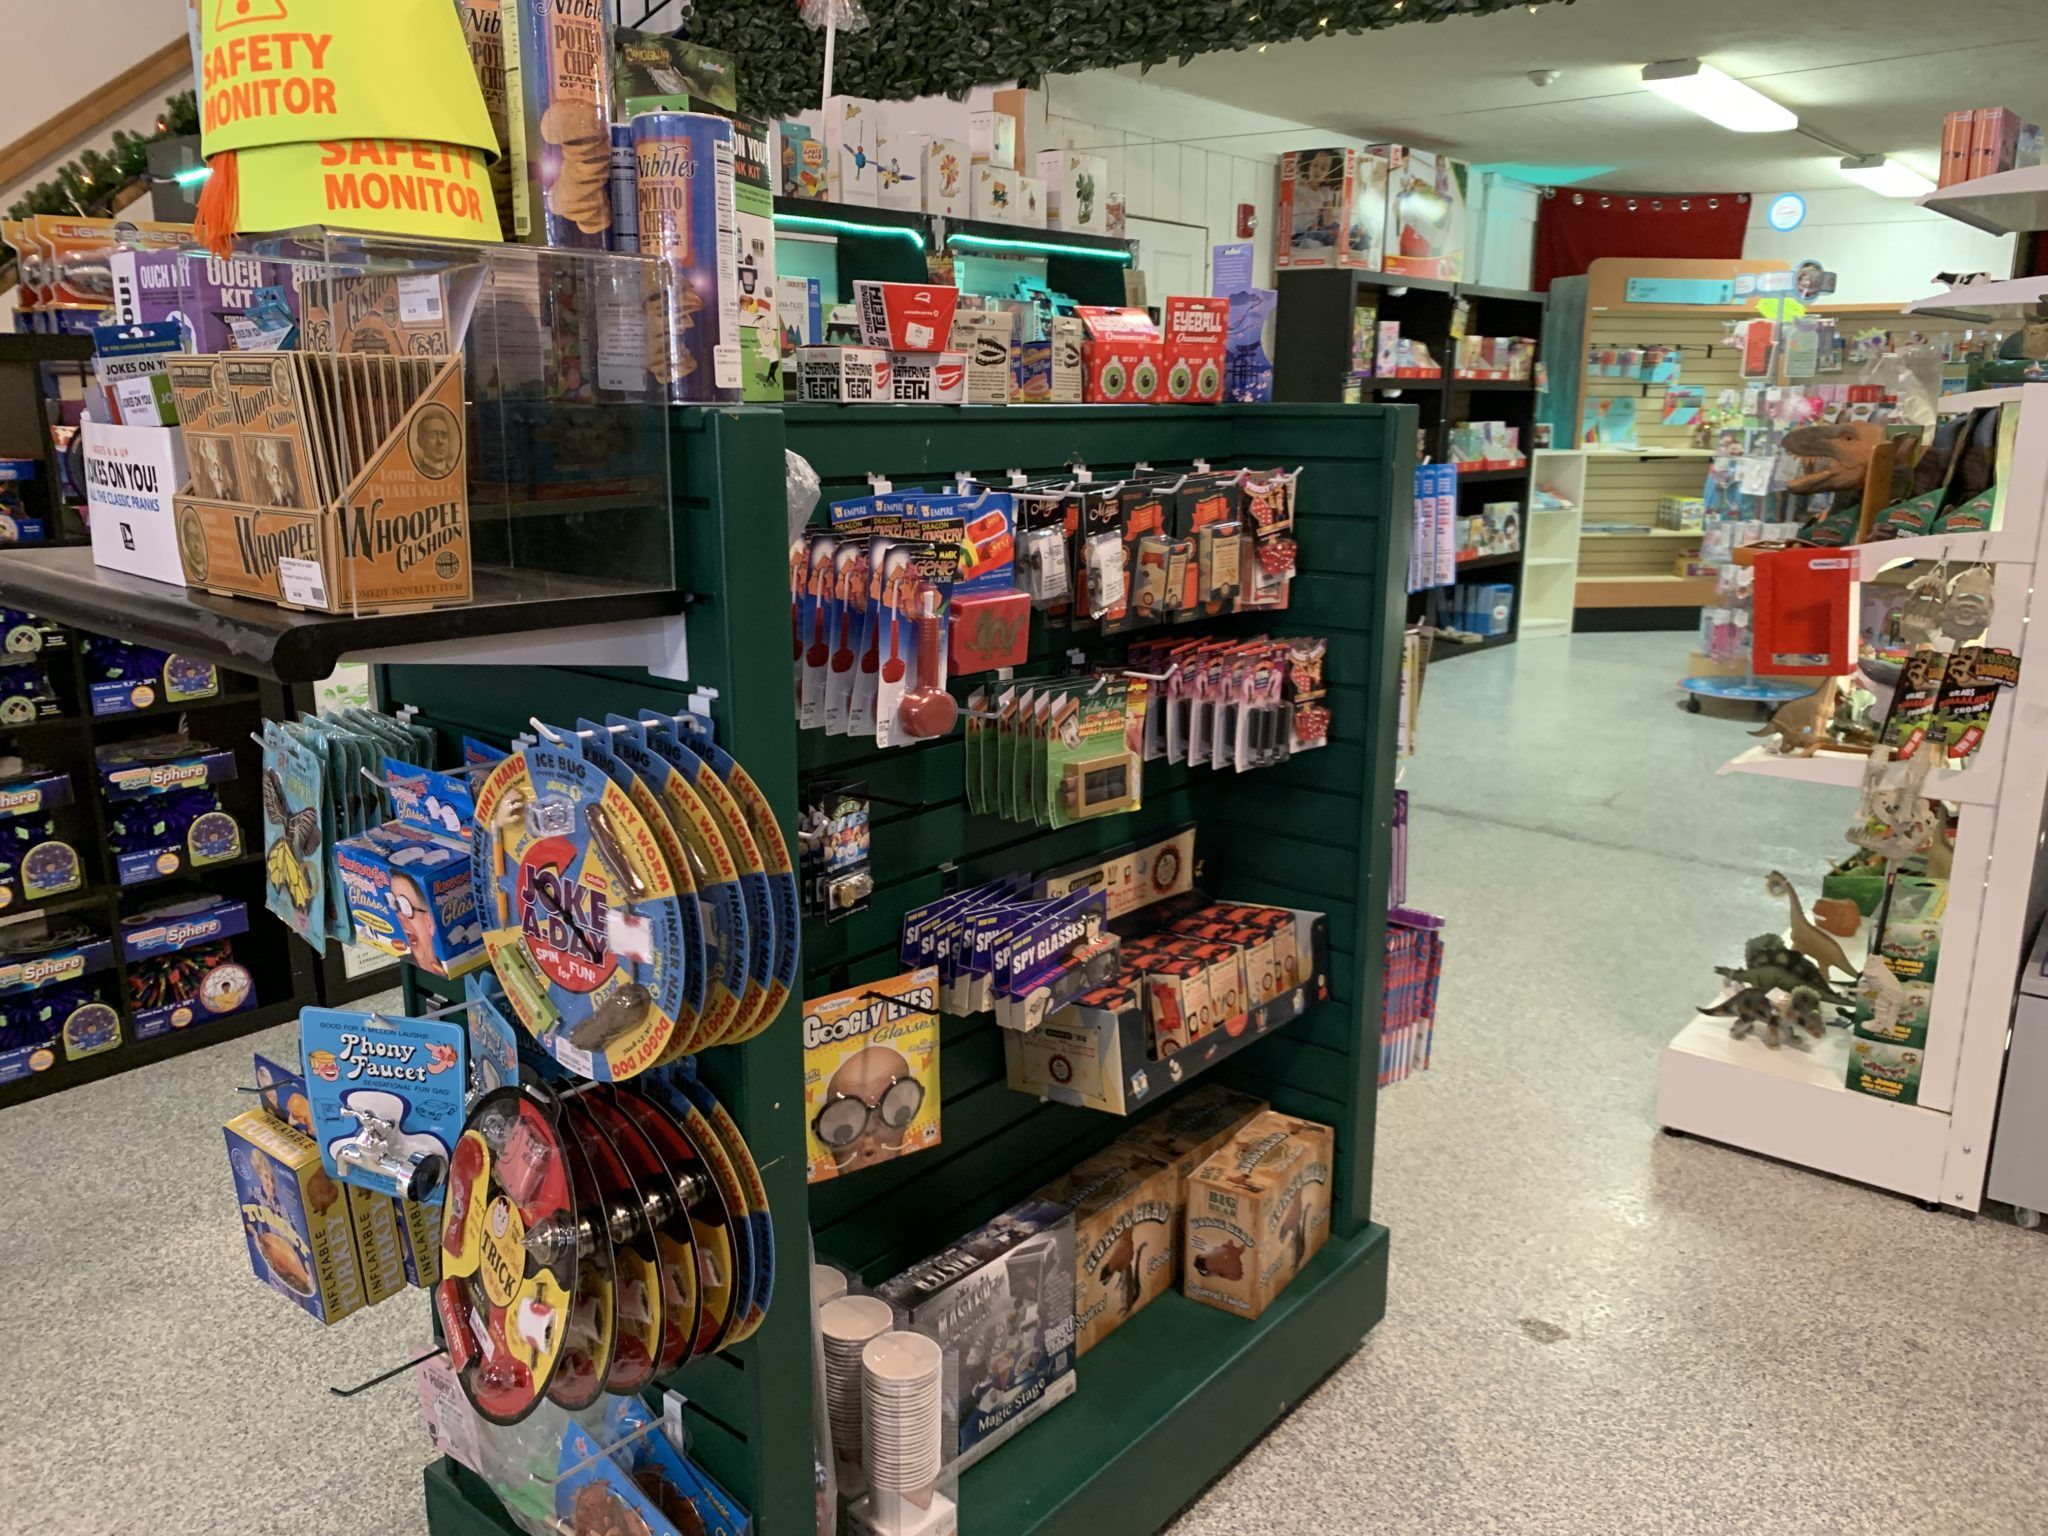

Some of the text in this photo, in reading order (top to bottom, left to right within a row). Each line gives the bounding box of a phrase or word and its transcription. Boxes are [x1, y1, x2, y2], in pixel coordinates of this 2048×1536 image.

[554, 25, 601, 55] POTATO
[203, 33, 333, 91] SAFETY
[564, 51, 599, 77] CHIPS
[204, 77, 338, 136] MONITOR
[320, 138, 474, 179] SAFETY
[636, 144, 699, 179] Nibbles
[324, 173, 484, 223] MONITOR
[639, 187, 682, 211] POTATO
[140, 264, 169, 289] OUCH
[206, 258, 262, 288] OUCH
[221, 289, 252, 308] KIT
[869, 286, 886, 334] TEETH
[1173, 311, 1222, 332] EYEBALL
[106, 361, 138, 375] JOKES
[138, 359, 155, 372] ON
[805, 377, 840, 399] TEETH
[845, 378, 872, 399] TEETH
[108, 461, 126, 489] ON
[125, 463, 158, 493] YOU!
[107, 492, 131, 508] CLASSIC
[131, 496, 160, 512] PRANKS
[843, 506, 868, 517] EMPIRE
[883, 502, 903, 513] EMPIR
[931, 506, 954, 517] EMPIRE
[336, 498, 461, 564] WHOOPEE
[874, 517, 899, 525] DRAGON
[904, 521, 919, 529] DRAG
[921, 521, 949, 530] DRAGON
[234, 510, 316, 583] WHOOPEE
[396, 526, 462, 574] CUSHION
[940, 551, 957, 559] MAGIC
[392, 584, 437, 595] NOVELTY
[152, 766, 204, 786] Sphere
[535, 753, 586, 779] ICE BUG
[477, 756, 526, 823] TINY HAND
[397, 801, 431, 826] Glasses
[670, 776, 732, 877] ICKY WORM
[701, 769, 759, 867] ICKY WORM
[732, 770, 788, 868] ICKY WORM
[607, 787, 670, 892] ICKY WORM
[634, 785, 691, 888] ICKY WORM
[349, 885, 390, 915] Glasses
[442, 897, 474, 927] Glas
[521, 863, 608, 935] JOKE
[168, 922, 218, 944] Sphere
[726, 884, 746, 992] FINGER NAIL
[754, 875, 771, 983] FINGER NAIL
[536, 948, 559, 964] SPIN
[663, 899, 681, 1014] FINGER NAIL
[995, 946, 1010, 970] SP
[1013, 922, 1087, 975] SPY GLASSES
[24, 957, 81, 981] Sphere
[558, 961, 596, 984] for FUN!
[702, 994, 736, 1037] DOGGY
[887, 988, 933, 1021] EYES
[320, 1022, 342, 1030] GOOD
[343, 1024, 359, 1032] FOR
[368, 1027, 397, 1036] MILLION
[873, 1017, 937, 1043] Glasses
[339, 1033, 417, 1063] Phony
[612, 1015, 671, 1077] DOGGY DOO
[346, 1055, 427, 1082] Faucet
[363, 1079, 412, 1092] SENSATIONAL
[414, 1085, 430, 1094] FUN
[237, 1117, 308, 1161] TURKEY
[258, 1113, 317, 1150] INFLATABLE
[690, 1113, 717, 1149] ICKY
[715, 1109, 740, 1145] ICKY
[1209, 1190, 1237, 1208] BIG
[359, 1211, 383, 1295] INFLATABLE
[371, 1200, 401, 1294] TURKEY
[409, 1200, 433, 1278] INFLATABL
[1083, 1200, 1171, 1276] HORSE HEAD
[315, 1228, 340, 1314] INFLATABLE
[327, 1215, 360, 1313] TURKEY
[481, 1229, 517, 1299] TRICK
[978, 1402, 1012, 1433] Magic
